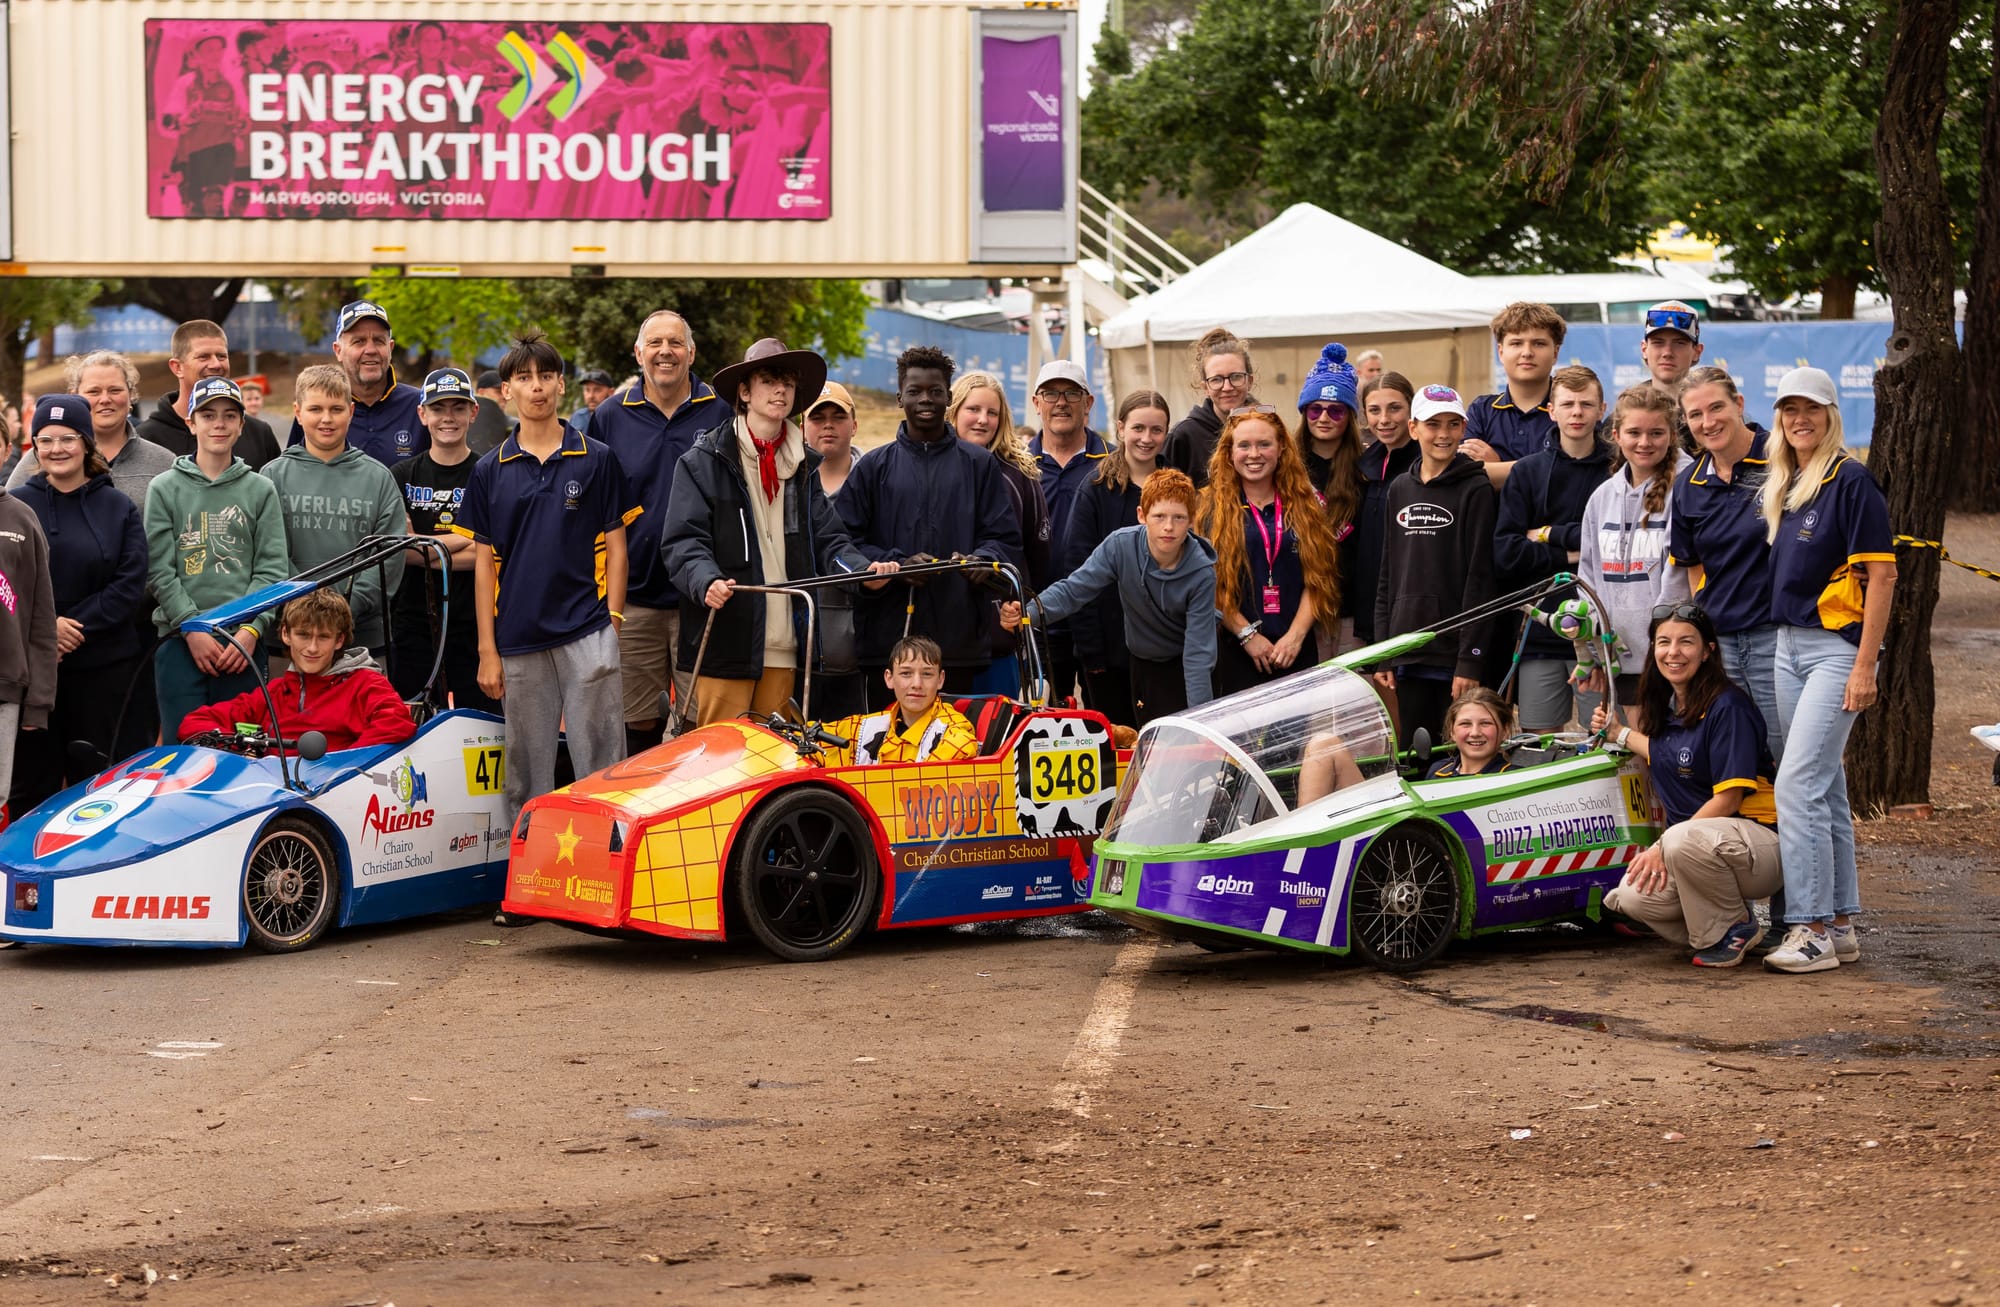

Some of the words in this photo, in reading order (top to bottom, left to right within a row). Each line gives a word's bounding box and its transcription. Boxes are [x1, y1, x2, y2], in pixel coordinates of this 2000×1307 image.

[249, 73, 484, 123] ENERGY
[987, 122, 1029, 136] regional
[1030, 121, 1059, 133] roads
[1019, 132, 1059, 143] victoria
[250, 131, 730, 182] BREAKTHROUGH
[251, 191, 395, 207] MARYBOROUGH,
[400, 192, 485, 206] VICTORIA
[453, 487, 466, 503] S
[291, 515, 322, 529] RNX
[1400, 512, 1450, 525] Champion
[475, 749, 502, 791] 47
[1035, 752, 1096, 798] 348
[899, 780, 1000, 839] WOODY
[1487, 809, 1525, 824] Chairo
[1527, 801, 1578, 818] Christian
[1578, 794, 1611, 812] School
[1629, 777, 1646, 819] 46
[361, 793, 435, 851] Aliens
[457, 833, 478, 852] gbm
[483, 827, 511, 843] Bullion
[1493, 825, 1534, 858] BUZZ
[1539, 814, 1619, 851] LIGHTYEAR
[383, 841, 414, 856] Chairo
[904, 851, 947, 867] Chairo
[950, 846, 1006, 864] Christian
[1009, 842, 1049, 859] School
[362, 860, 402, 876] Christian
[405, 851, 433, 869] School
[515, 874, 534, 886] CHEF
[538, 877, 561, 889] FIELDS
[581, 879, 614, 890] WARRAGUL
[1214, 875, 1254, 895] gbm
[1280, 880, 1327, 898] Bullion
[91, 896, 210, 919] CLAAS
